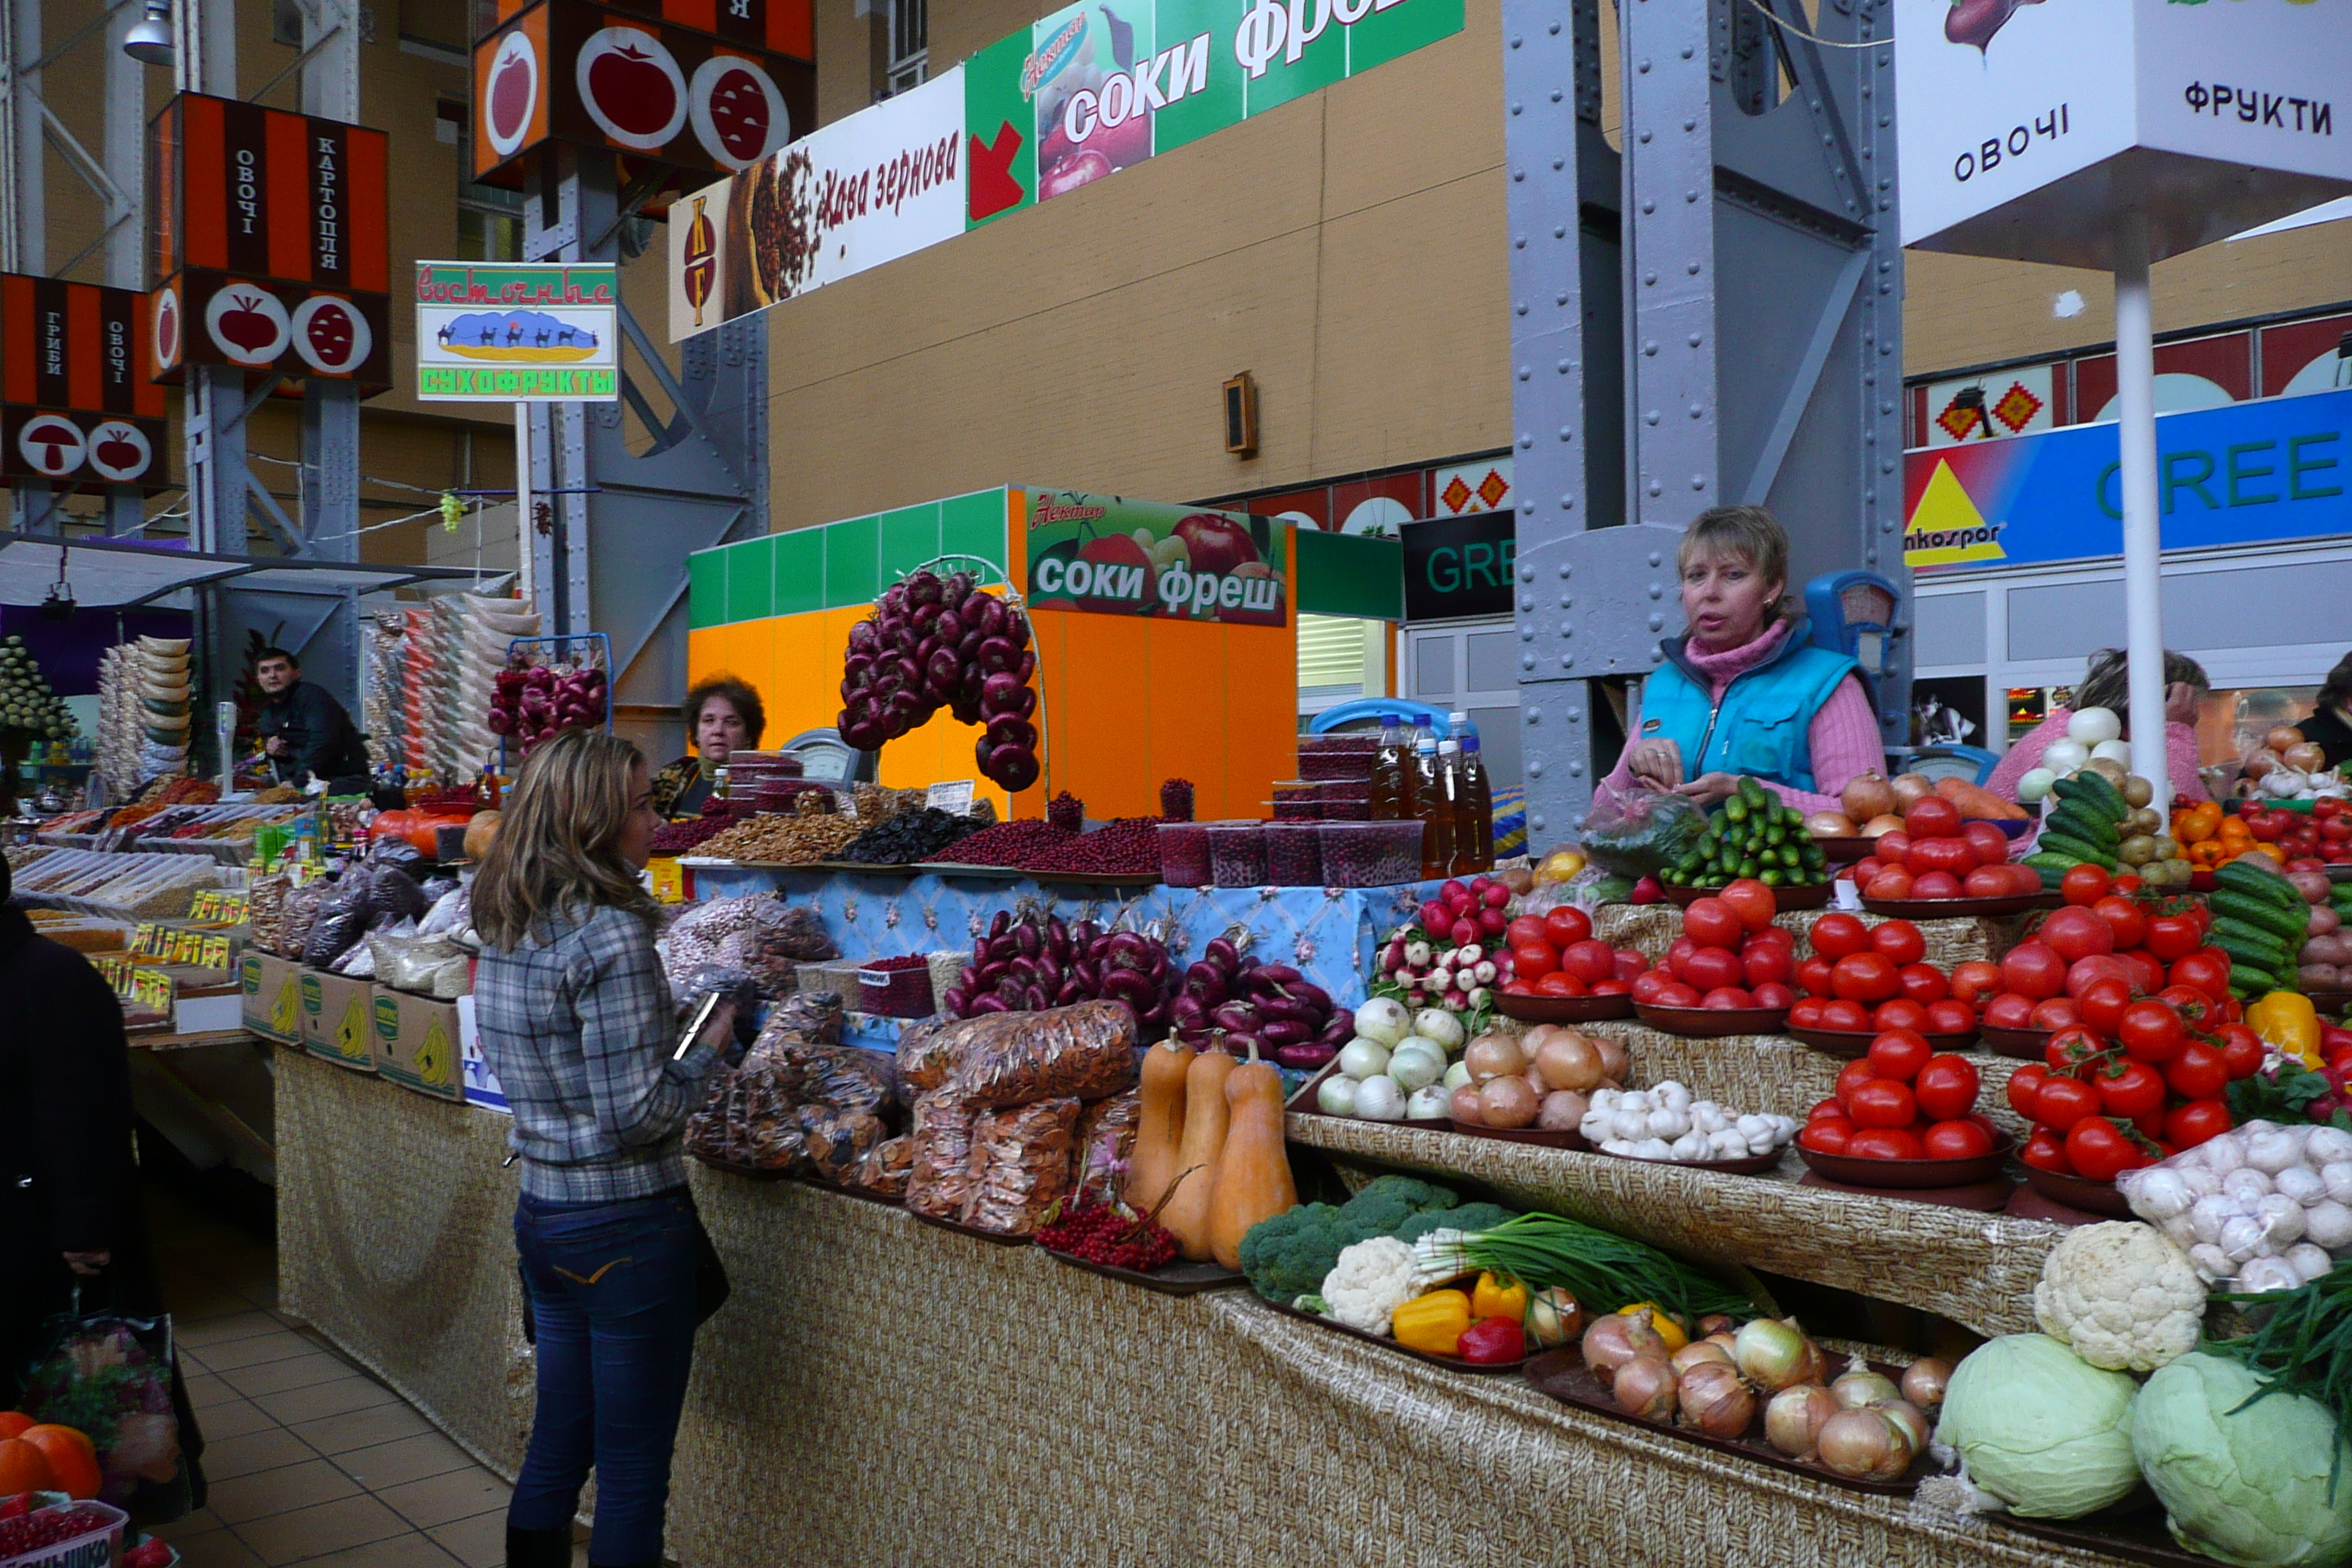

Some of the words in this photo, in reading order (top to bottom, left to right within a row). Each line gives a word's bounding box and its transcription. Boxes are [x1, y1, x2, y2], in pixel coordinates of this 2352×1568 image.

[1235, 0, 1409, 80] фр
[1954, 102, 2069, 183] ОВОЧІ
[2185, 81, 2333, 136] ФРУКТИ
[317, 137, 338, 270] КАРТОПЛЯ
[823, 167, 870, 230] Кава
[875, 129, 960, 216] зернова
[45, 312, 62, 375] ГРИБИ
[422, 369, 616, 394] СУХОФРУКТЫ
[1030, 493, 1107, 530] Нектар
